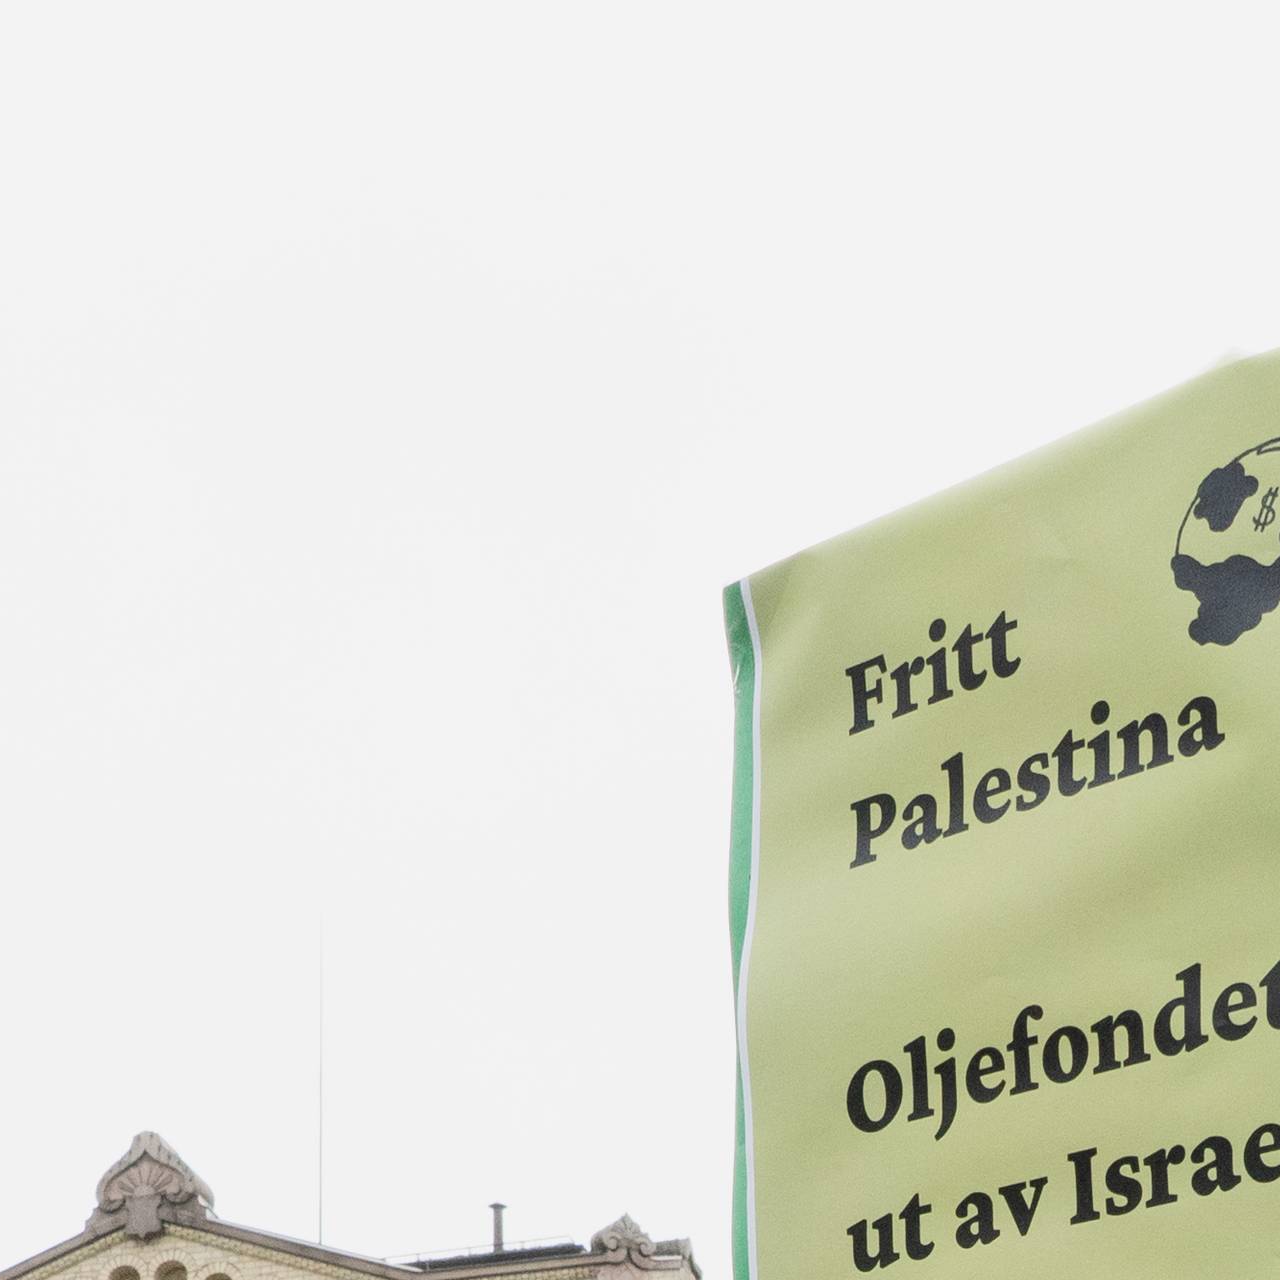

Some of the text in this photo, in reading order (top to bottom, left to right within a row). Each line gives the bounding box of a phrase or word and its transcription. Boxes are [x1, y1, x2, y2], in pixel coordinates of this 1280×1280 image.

[845, 611, 1022, 735] Fritt
[849, 696, 1226, 868] Palestina
[846, 1193, 935, 1273] ut
[955, 1176, 1049, 1249] av
